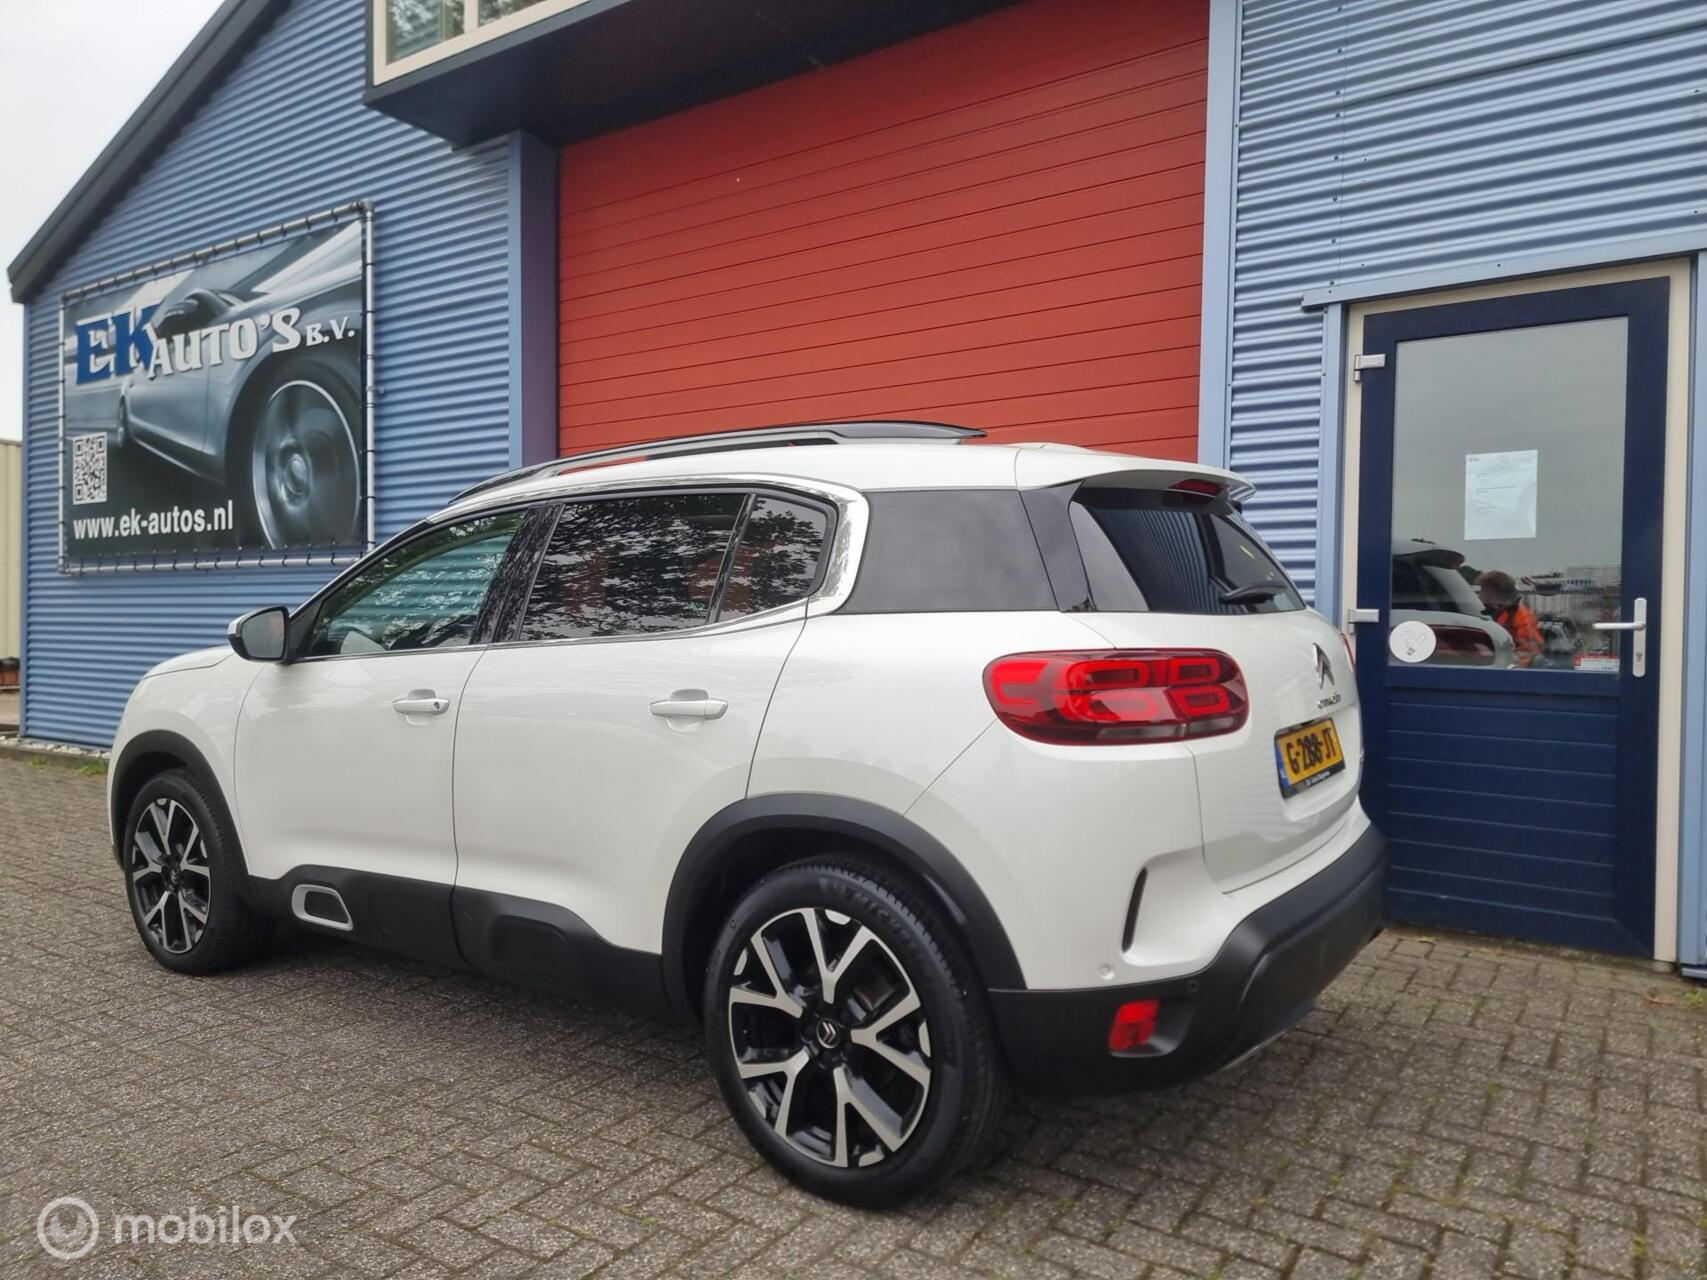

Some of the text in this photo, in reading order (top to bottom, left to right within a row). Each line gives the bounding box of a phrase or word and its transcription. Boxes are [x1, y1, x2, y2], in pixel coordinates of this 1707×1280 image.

[76, 302, 160, 384] EK
[305, 316, 355, 347] B.V.
[73, 500, 233, 540] www.ek-autos.nl
